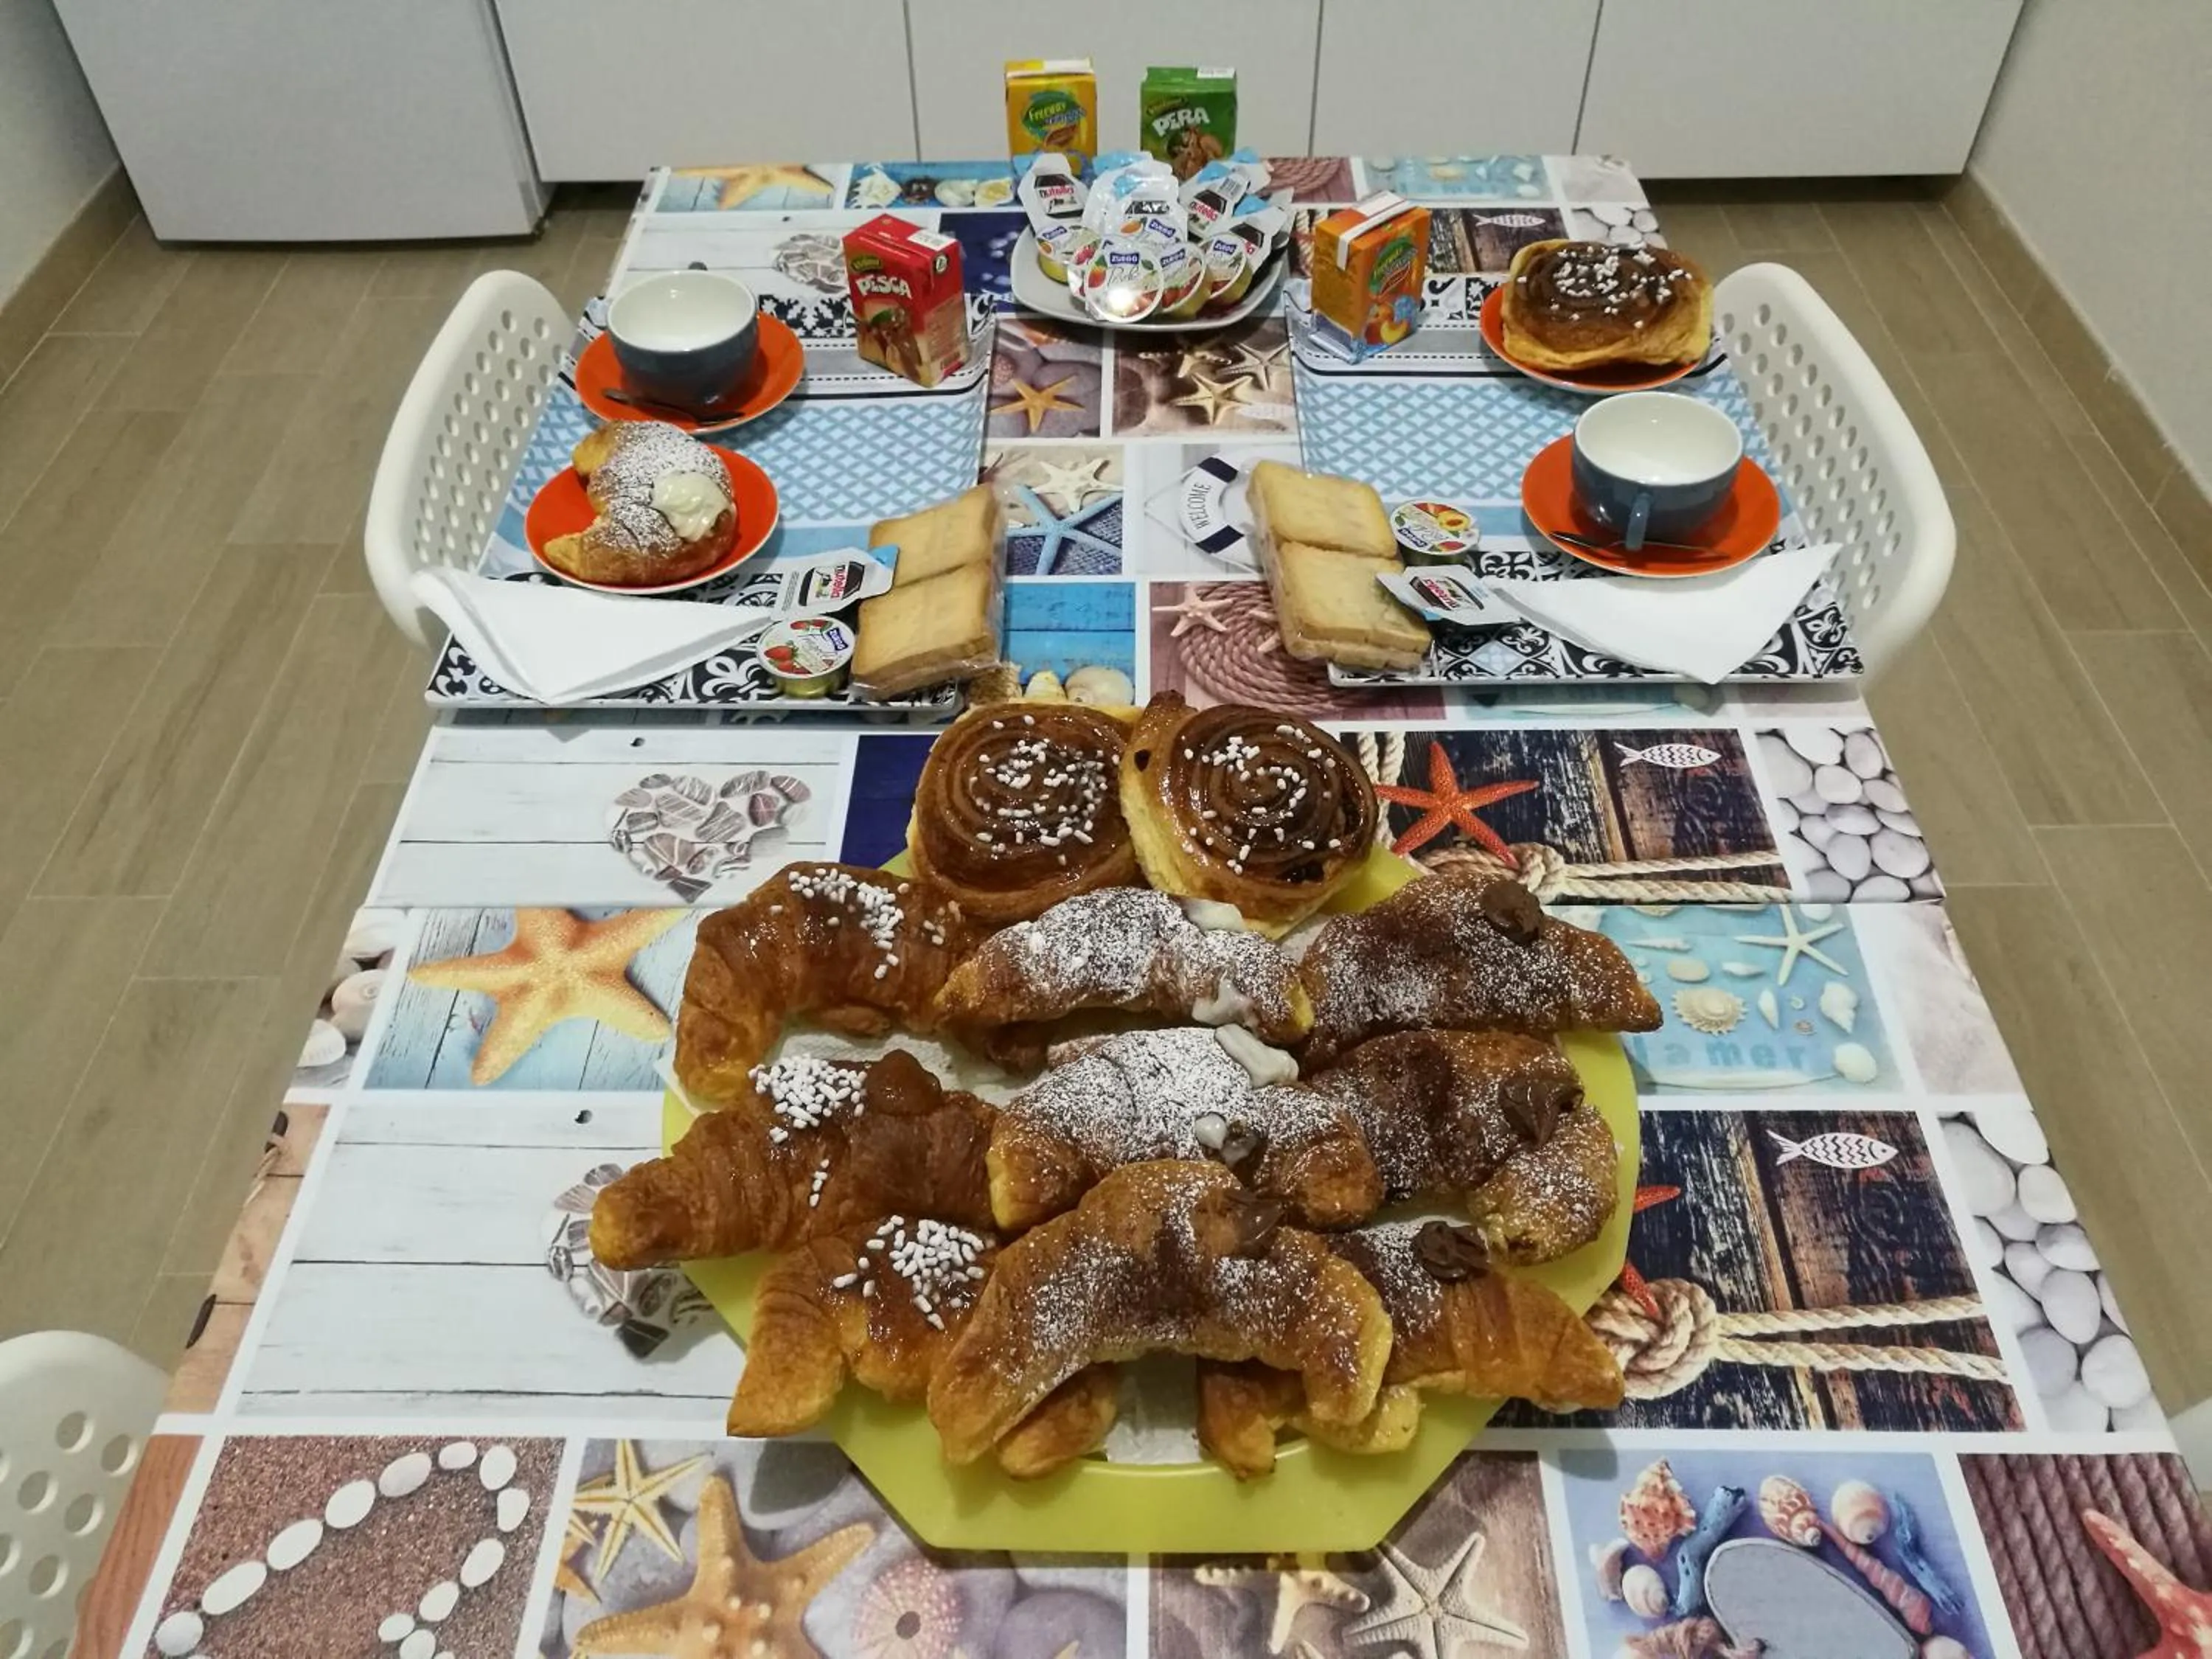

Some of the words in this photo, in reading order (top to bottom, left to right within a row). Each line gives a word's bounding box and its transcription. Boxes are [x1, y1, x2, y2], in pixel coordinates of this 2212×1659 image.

[1152, 107, 1211, 138] PERA
[855, 274, 913, 300] PESCA
[1187, 483, 1211, 529] WELCOME
